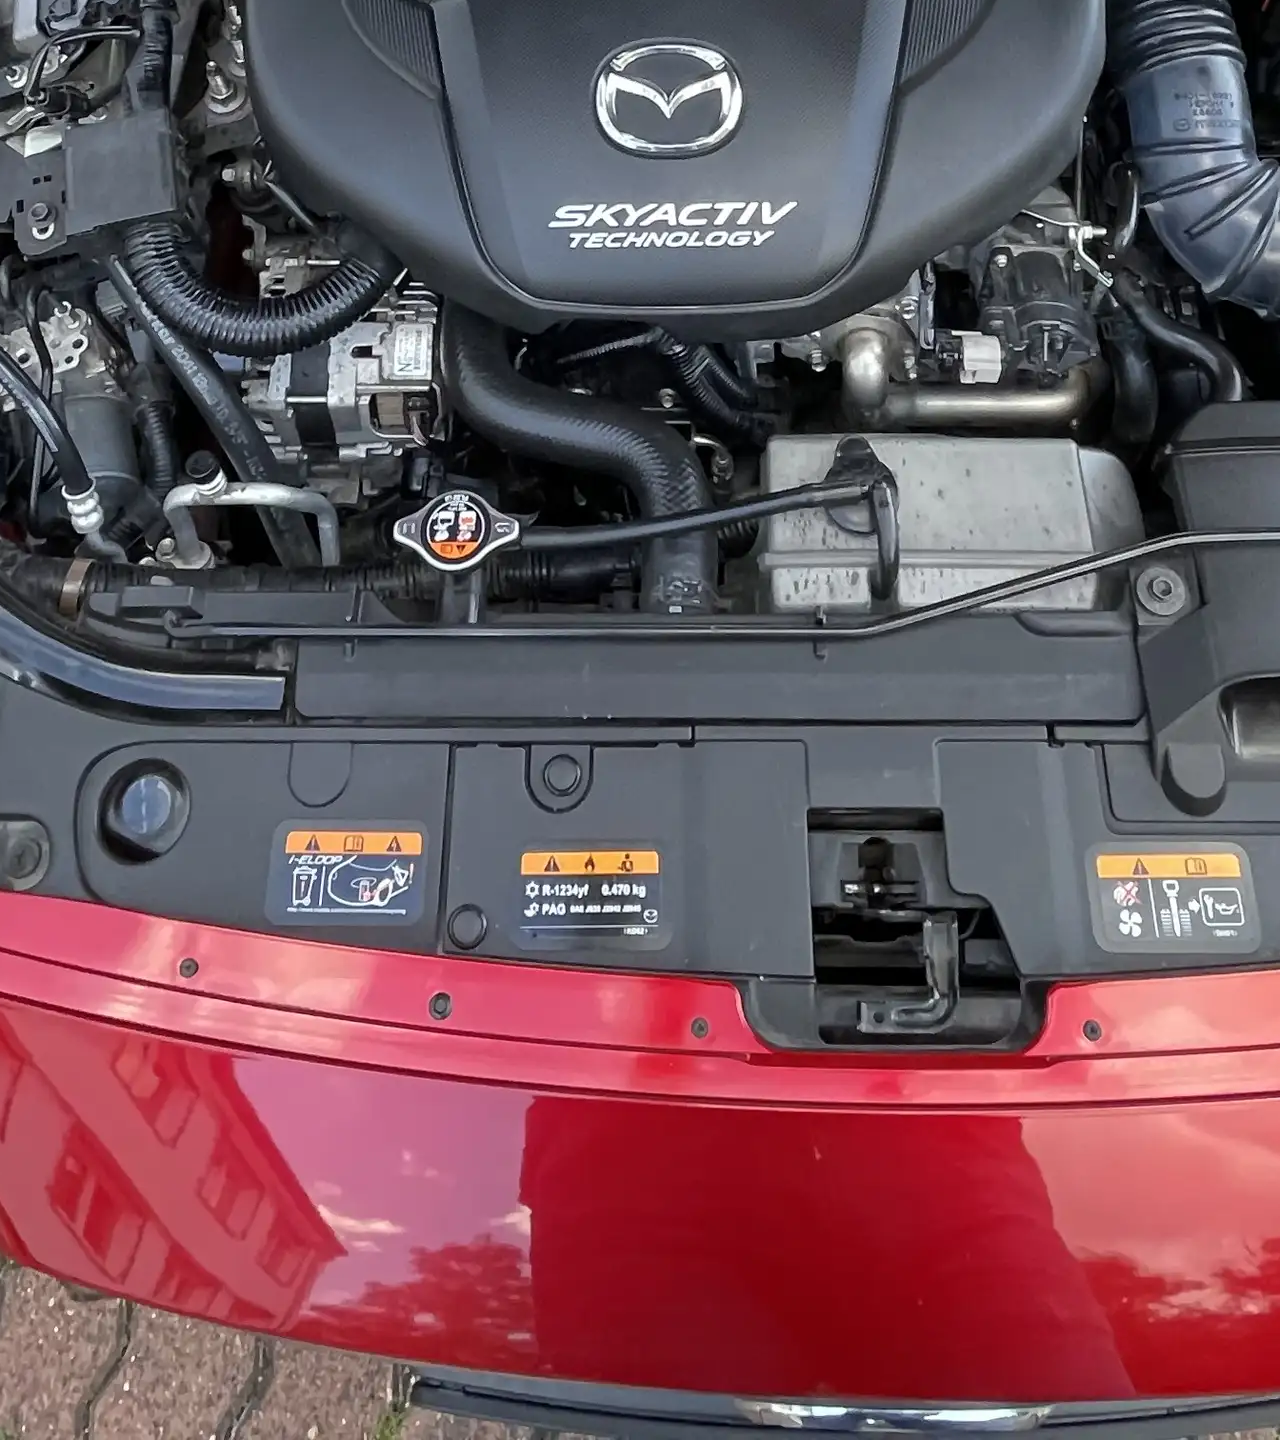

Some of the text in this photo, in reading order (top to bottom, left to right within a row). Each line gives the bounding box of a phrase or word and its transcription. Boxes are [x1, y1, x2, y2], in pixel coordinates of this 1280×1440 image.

[548, 201, 798, 229] SKYACTIV
[569, 230, 775, 249] TECHNOLOGY
[542, 883, 647, 899] R-1234yf 0.470 kg
[541, 902, 566, 915] PAG
